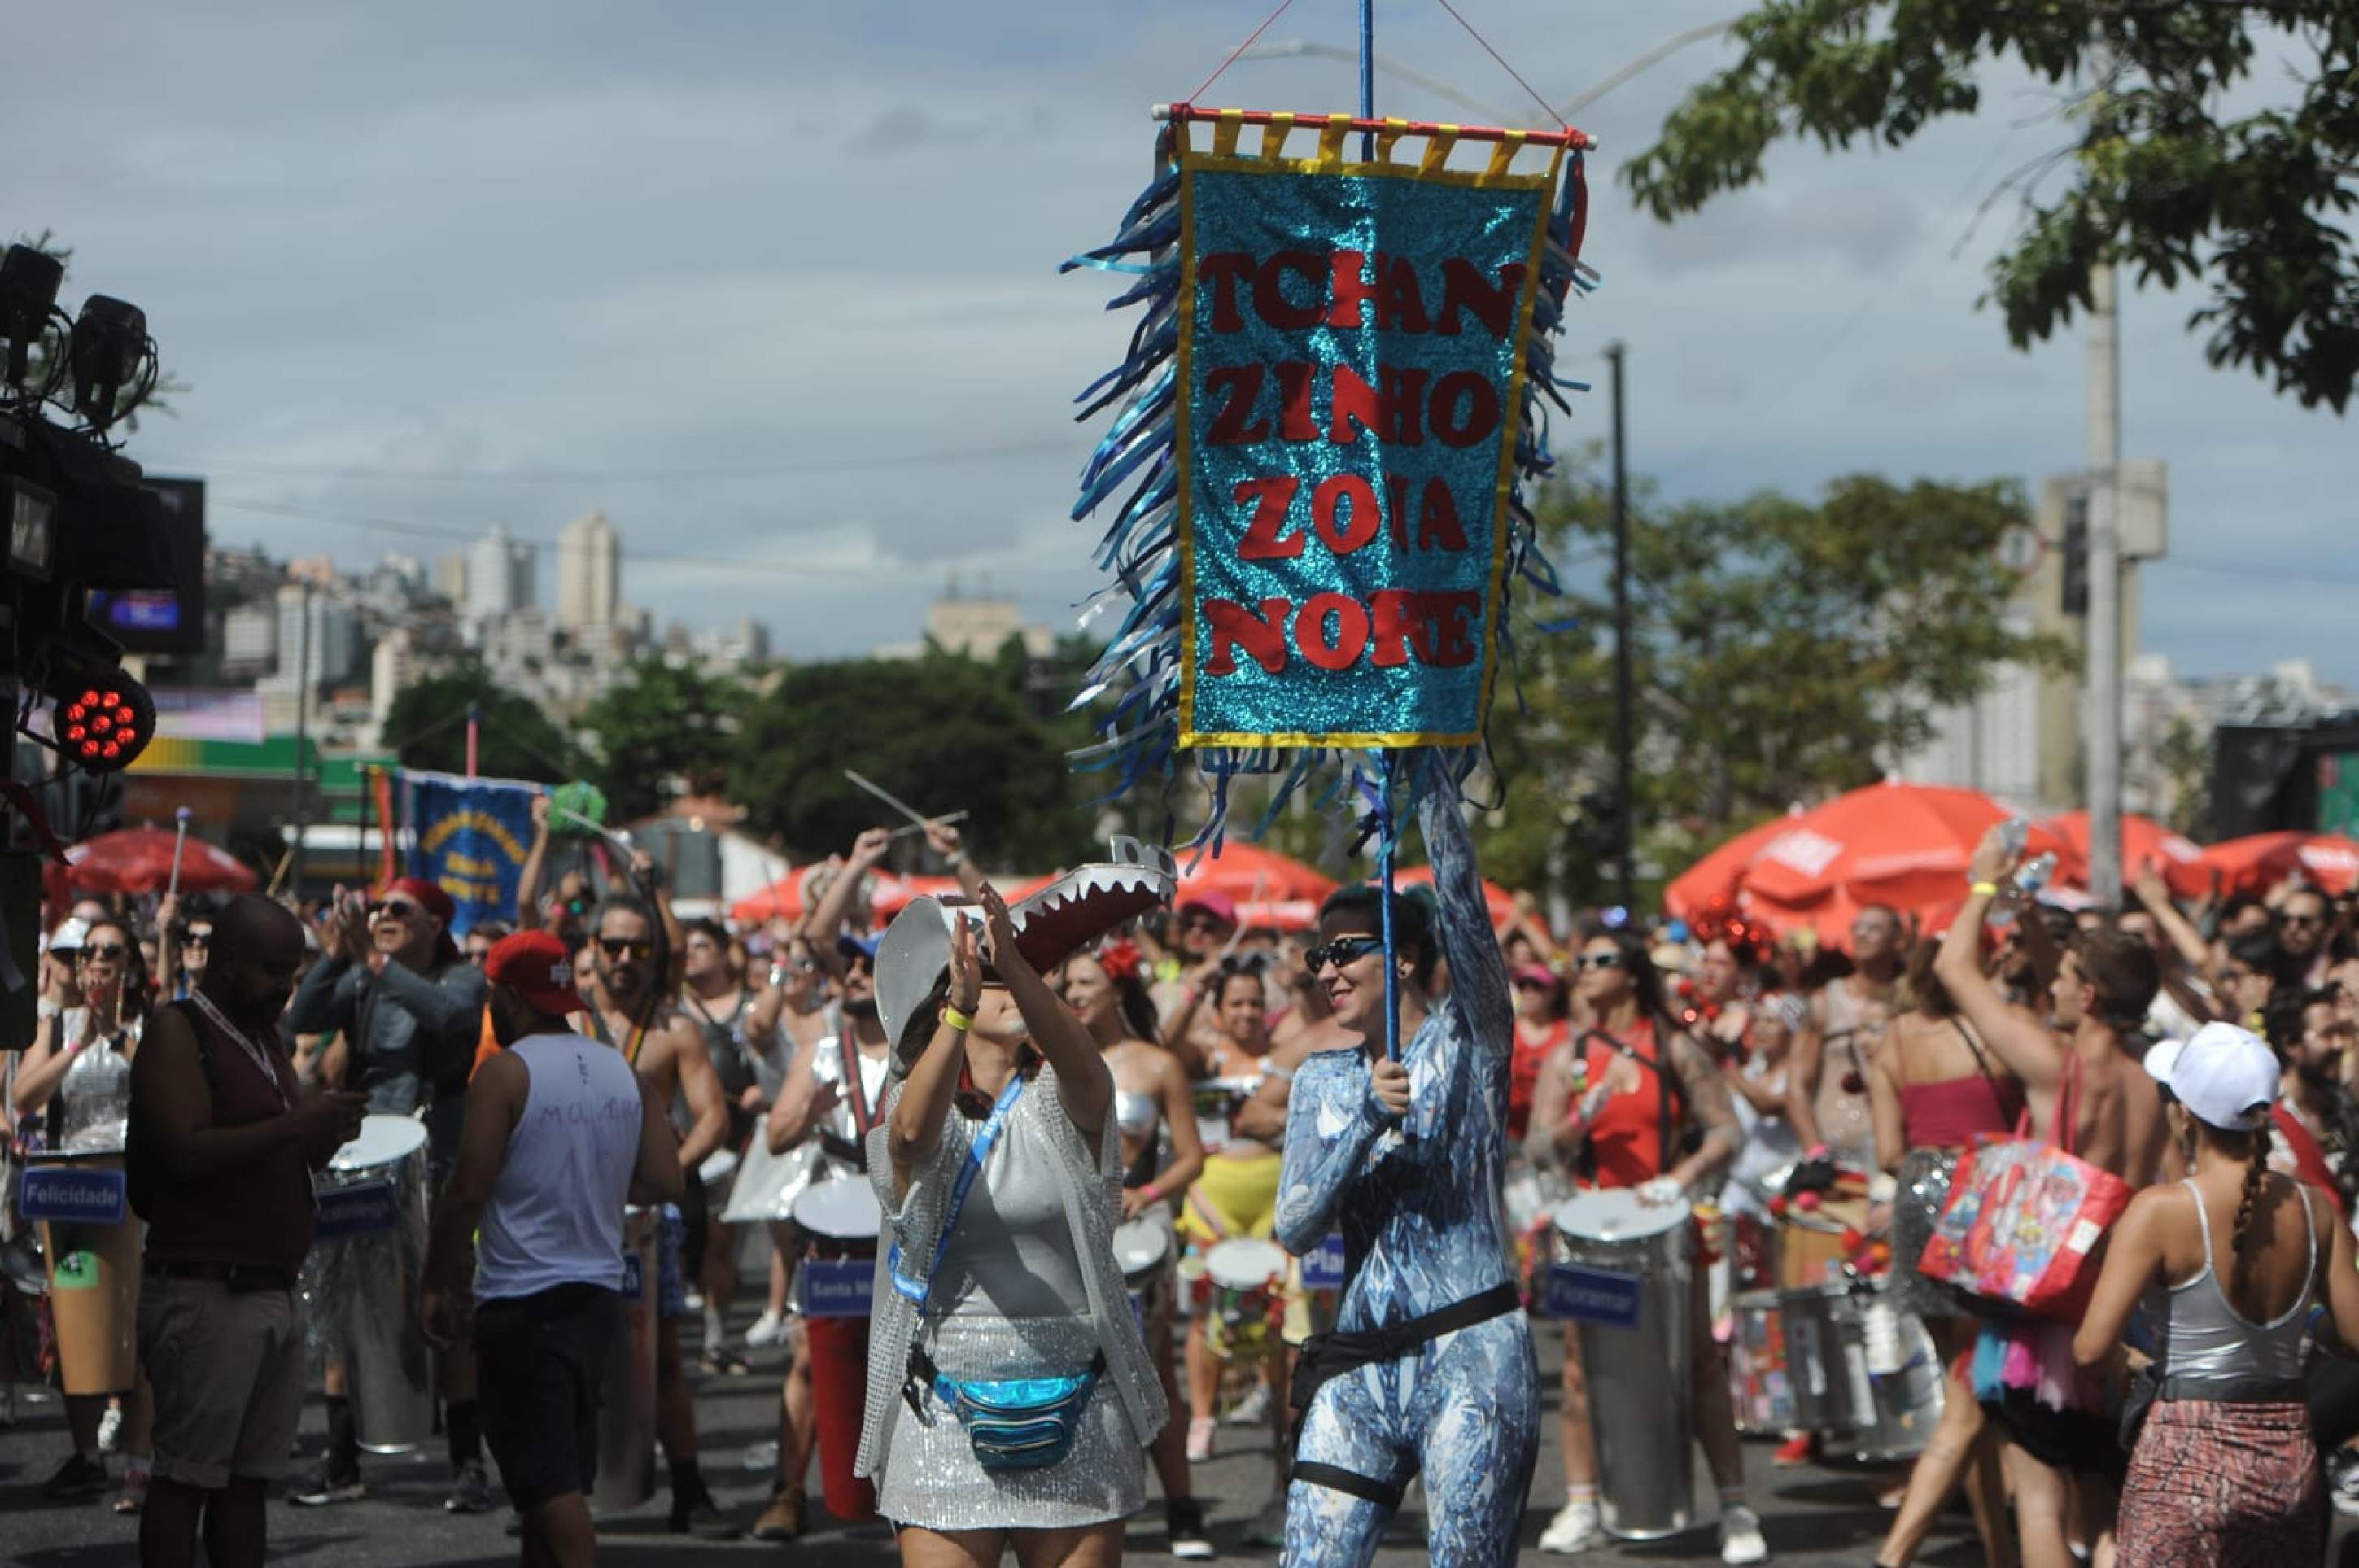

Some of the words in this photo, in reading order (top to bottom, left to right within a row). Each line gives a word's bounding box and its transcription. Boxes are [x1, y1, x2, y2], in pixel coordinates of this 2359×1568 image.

[1199, 250, 1527, 342] TCHAN
[1204, 360, 1501, 449] ZINHO
[27, 1183, 119, 1207] Felicidade
